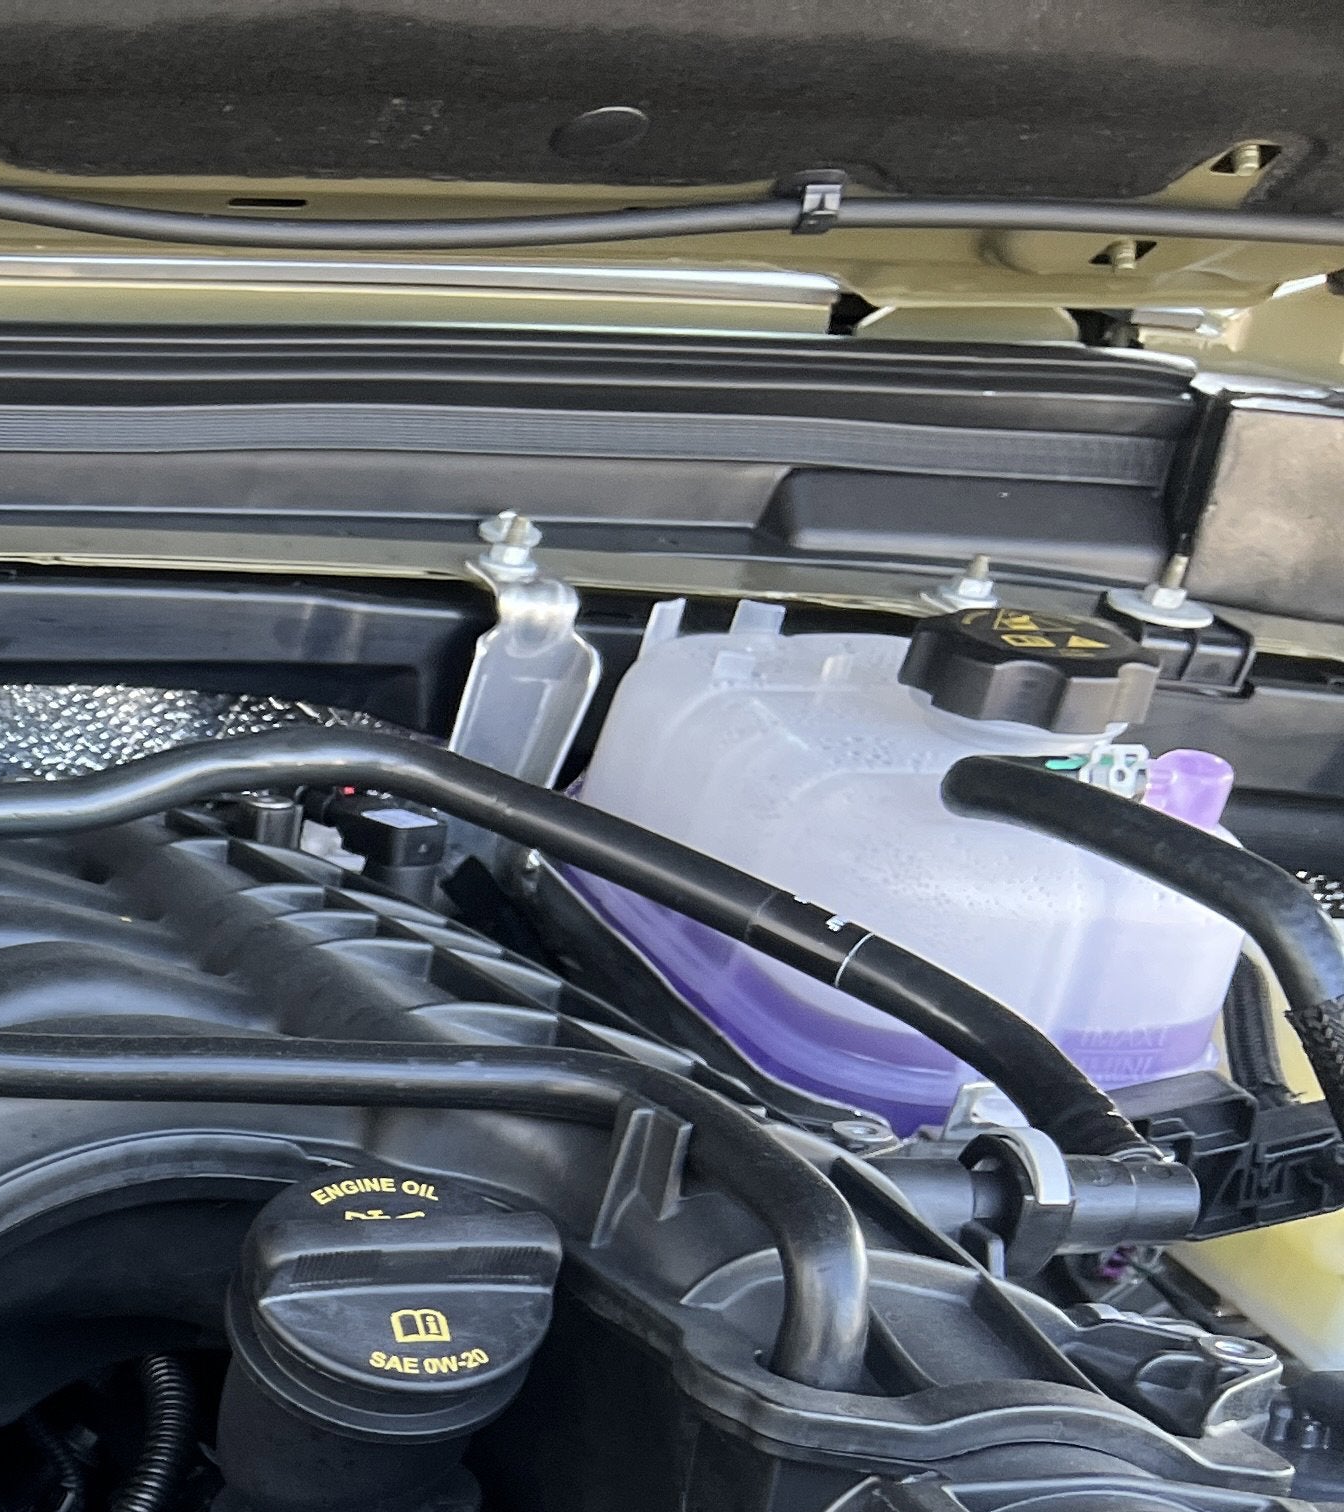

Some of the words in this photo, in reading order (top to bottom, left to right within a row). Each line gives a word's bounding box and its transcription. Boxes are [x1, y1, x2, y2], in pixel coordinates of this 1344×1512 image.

[310, 1177, 397, 1206] ENGINE
[400, 1180, 439, 1201] OIL
[368, 1350, 420, 1374] SAE
[422, 1348, 490, 1374] 0W-20
